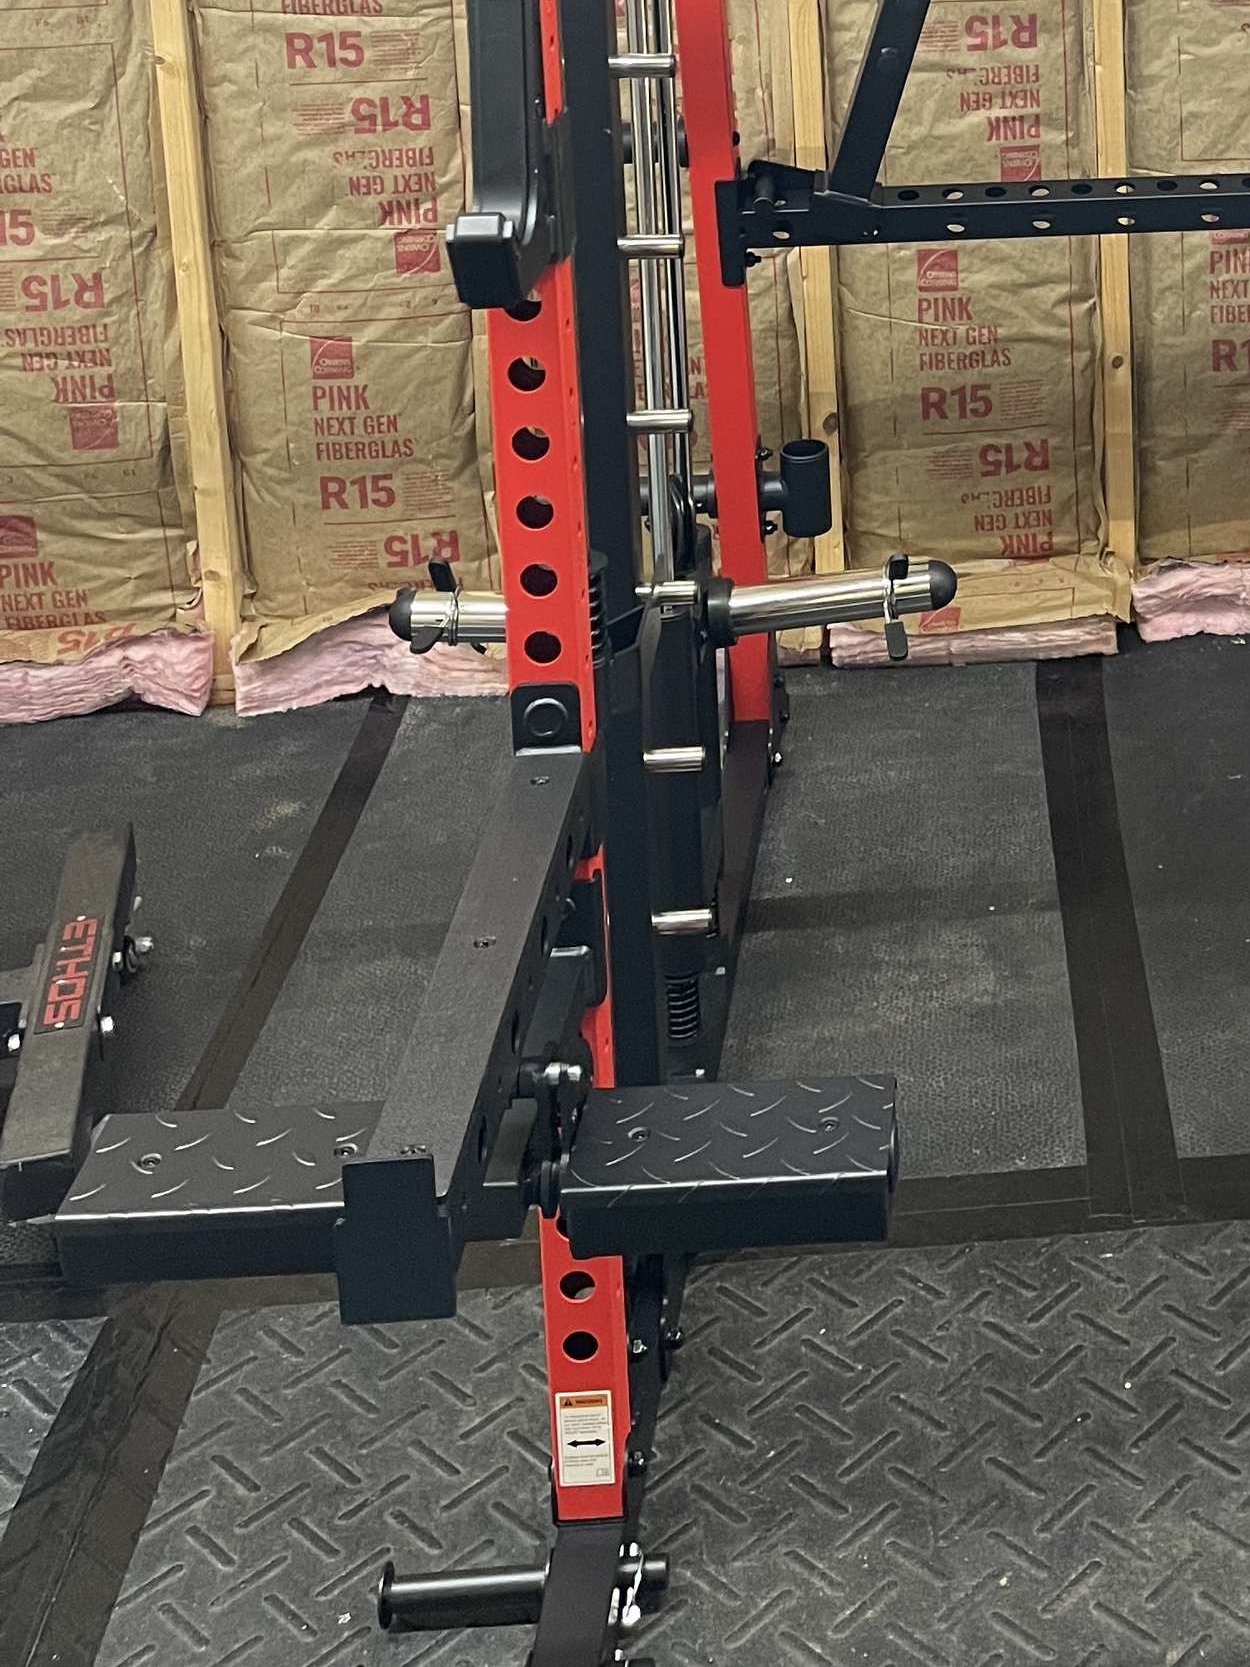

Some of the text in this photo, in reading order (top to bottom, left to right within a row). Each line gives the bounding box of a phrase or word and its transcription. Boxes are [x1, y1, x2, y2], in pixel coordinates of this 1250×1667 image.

[965, 13, 1038, 52] R15
[285, 31, 366, 69] R15
[959, 89, 1040, 112] NEXT GEN
[350, 94, 431, 134] R15
[986, 116, 1041, 142] PINK
[348, 174, 436, 197] NEXT GEN
[379, 198, 438, 225] PINK
[0, 209, 36, 246] 15
[22, 272, 105, 312] R15
[1210, 279, 1250, 299] NEXT
[918, 297, 974, 323] PINK
[3, 323, 109, 348] FIBERGLAS
[918, 326, 999, 345] NEXT GEN
[20, 349, 113, 373] NEXT GEN
[919, 348, 1012, 372] FIBERGLAS
[53, 374, 115, 403] PINK
[312, 384, 369, 411] PINK
[921, 385, 993, 421] R15
[314, 415, 398, 436] NEXT GEN
[315, 438, 414, 461] FIBERGLAS
[979, 438, 1049, 477] R15
[320, 474, 396, 511] R15
[974, 511, 1053, 532] NEXT GEN
[384, 530, 460, 568] R15
[1001, 532, 1054, 556] PINK
[0, 562, 56, 588] PINK
[2, 591, 89, 612] NEXT GEN
[43, 917, 97, 1029] ETHOS
